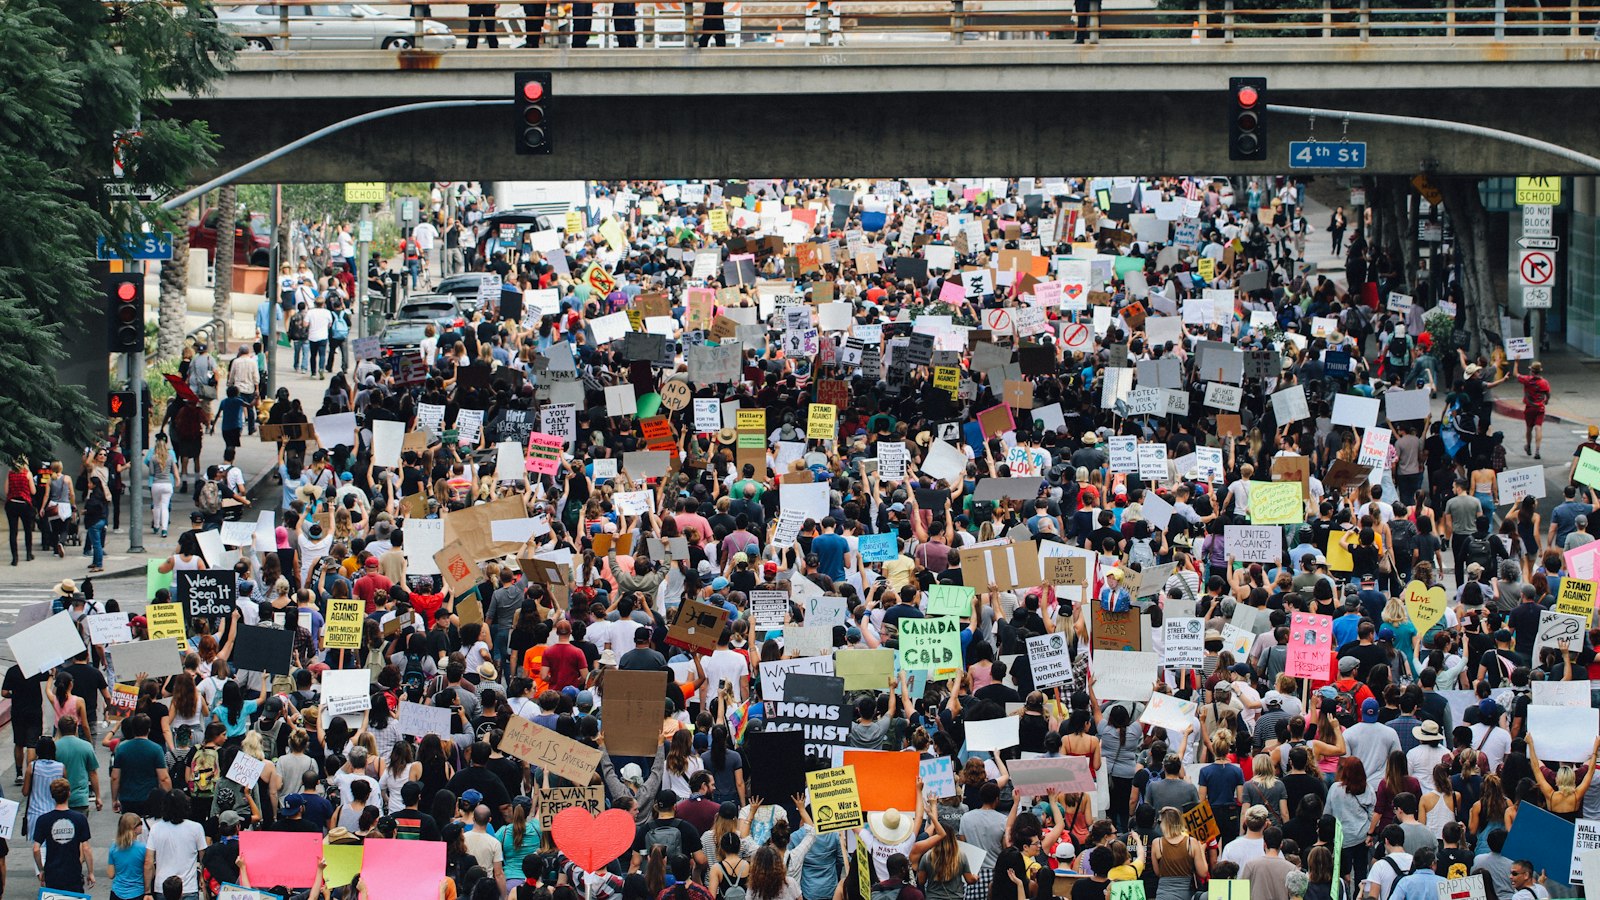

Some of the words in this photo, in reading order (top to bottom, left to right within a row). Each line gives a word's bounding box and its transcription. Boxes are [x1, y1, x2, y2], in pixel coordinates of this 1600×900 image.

[1295, 147, 1330, 163] 4th
[1338, 149, 1360, 162] St
[348, 190, 383, 200] SCHOOL
[1519, 191, 1557, 202] SCHOOL
[1525, 207, 1535, 215] DO
[1538, 207, 1550, 215] NOT
[1524, 218, 1551, 227] BLOCK
[144, 238, 166, 253] St
[775, 295, 803, 304] OBSTRUCT
[1327, 362, 1349, 371] THINK
[668, 384, 687, 395] NO
[819, 381, 847, 391] CIVIL
[1128, 389, 1158, 399] PROTECT
[662, 393, 683, 409] DAPL
[1129, 403, 1158, 412] PUSSY
[549, 410, 566, 418] YOU
[496, 421, 516, 432] NEVER
[644, 421, 663, 429] TRUMP
[1361, 456, 1383, 468] HATE
[1508, 475, 1530, 484] UNITED
[1513, 490, 1527, 498] HATE
[1240, 530, 1270, 539] UNITED
[1234, 540, 1273, 549] AGAINST
[1243, 551, 1268, 560] HATE
[184, 574, 216, 588] We've
[189, 586, 216, 599] Seen
[217, 584, 231, 599] It
[1566, 582, 1591, 592] STAND
[934, 587, 973, 608] ALLY
[1563, 590, 1591, 602] AGAINST
[191, 598, 231, 615] Before
[333, 602, 358, 611] STAND
[1558, 604, 1592, 615] ANTI-MUSLIM
[330, 612, 358, 621] AGAINST
[1541, 614, 1558, 623] SAFE
[326, 625, 360, 633] ANTI-MUSLIM
[902, 620, 956, 635] CANADA
[1105, 625, 1127, 636] ASS
[329, 633, 357, 643] BIGOTRY!
[915, 637, 924, 645] is
[1029, 640, 1044, 649] WALL
[904, 647, 953, 664] COLD
[1030, 646, 1050, 655] STREET
[1294, 651, 1307, 660] NOT
[1311, 651, 1325, 660] MY
[764, 664, 800, 677] WAIT
[1033, 664, 1048, 674] FOR
[1049, 662, 1062, 670] THE
[1035, 670, 1070, 682] WORKERS
[112, 690, 138, 700] DONALD
[776, 702, 839, 720] MOMS
[765, 721, 850, 742] AGAINST
[507, 729, 542, 749] AMERICA
[541, 740, 560, 762] IS
[562, 752, 596, 773] DIVERSITY
[815, 771, 830, 780] Fight
[830, 769, 845, 777] Back
[810, 781, 832, 791] Against
[540, 789, 561, 804] WE
[562, 787, 598, 800] WANT
[838, 802, 851, 810] War
[835, 811, 859, 820] Racism
[1185, 803, 1213, 830] HELL
[1578, 825, 1597, 833] WALL
[1576, 841, 1582, 849] IS
[1582, 841, 1594, 849] THE
[1438, 877, 1484, 895] RAPISTS
